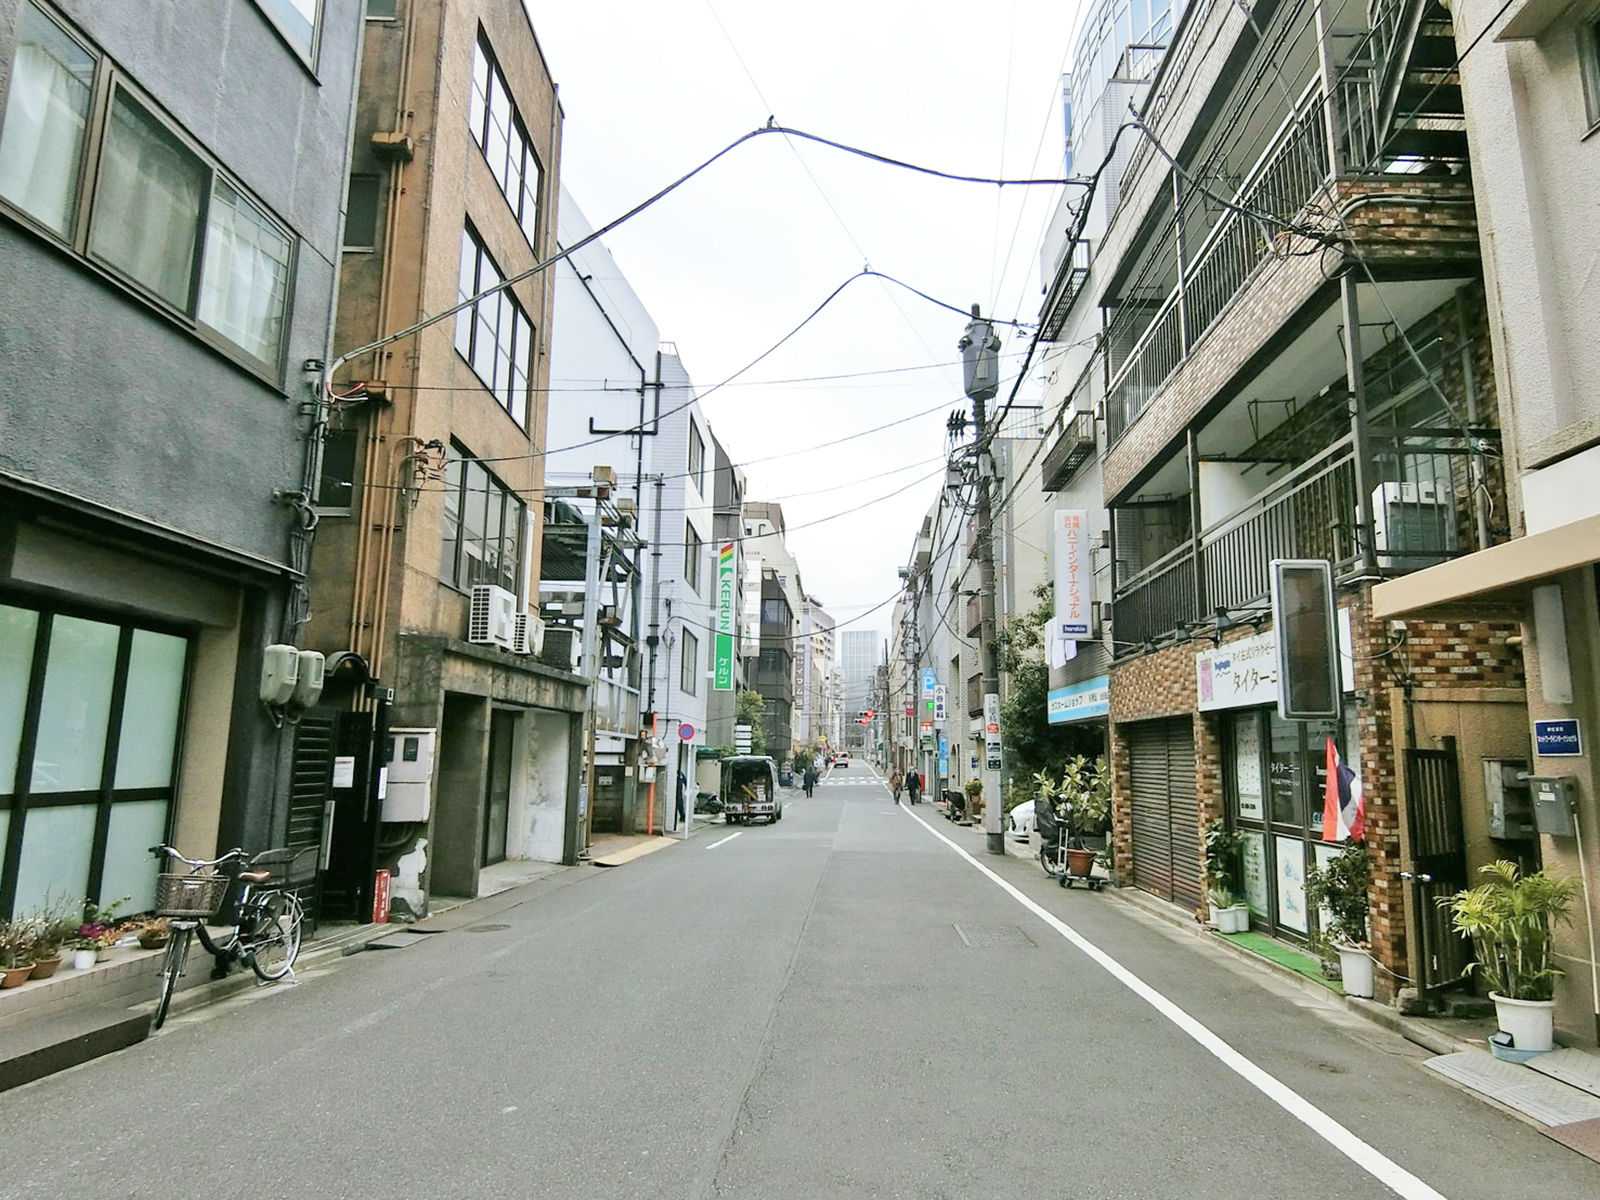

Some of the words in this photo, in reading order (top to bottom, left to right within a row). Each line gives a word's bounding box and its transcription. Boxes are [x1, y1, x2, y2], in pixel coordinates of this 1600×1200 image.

[1066, 529, 1080, 619] ハニーインターナショナル
[720, 579, 731, 630] KERUN
[718, 657, 730, 685] ケルン
[923, 675, 934, 690] P
[935, 686, 945, 719] 小谷歯科
[1270, 762, 1301, 774] タイターニー
